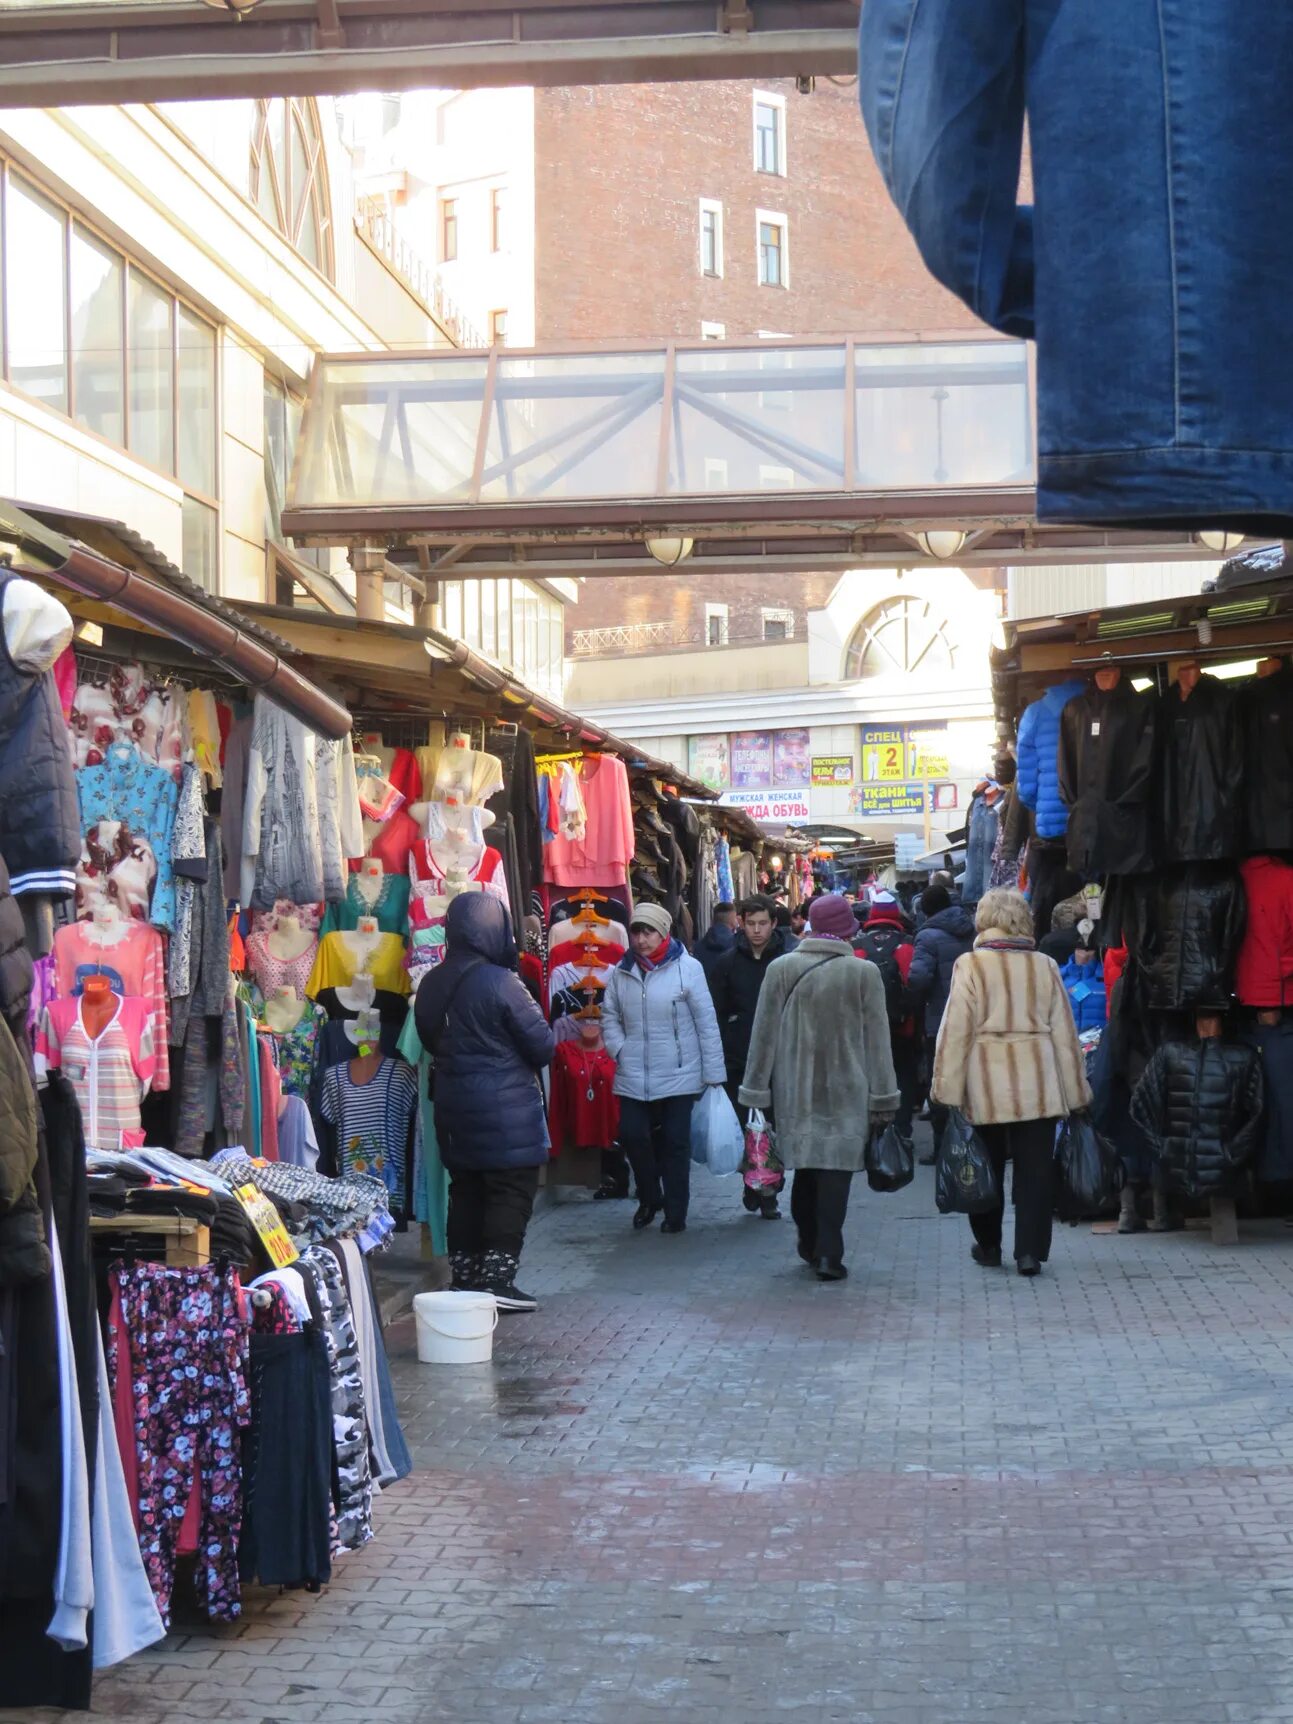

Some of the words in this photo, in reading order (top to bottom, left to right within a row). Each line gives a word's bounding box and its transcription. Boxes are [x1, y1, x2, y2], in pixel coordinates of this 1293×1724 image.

[865, 731, 901, 743] СПЕЦ
[885, 747, 897, 767] 2
[882, 768, 901, 776] ЭТАЖ
[730, 794, 764, 802] МУЖСКАЯ
[768, 793, 802, 801] ЖЕНСКАЯ
[745, 804, 770, 819] ЖДА
[773, 803, 808, 817] ОБУВЬ
